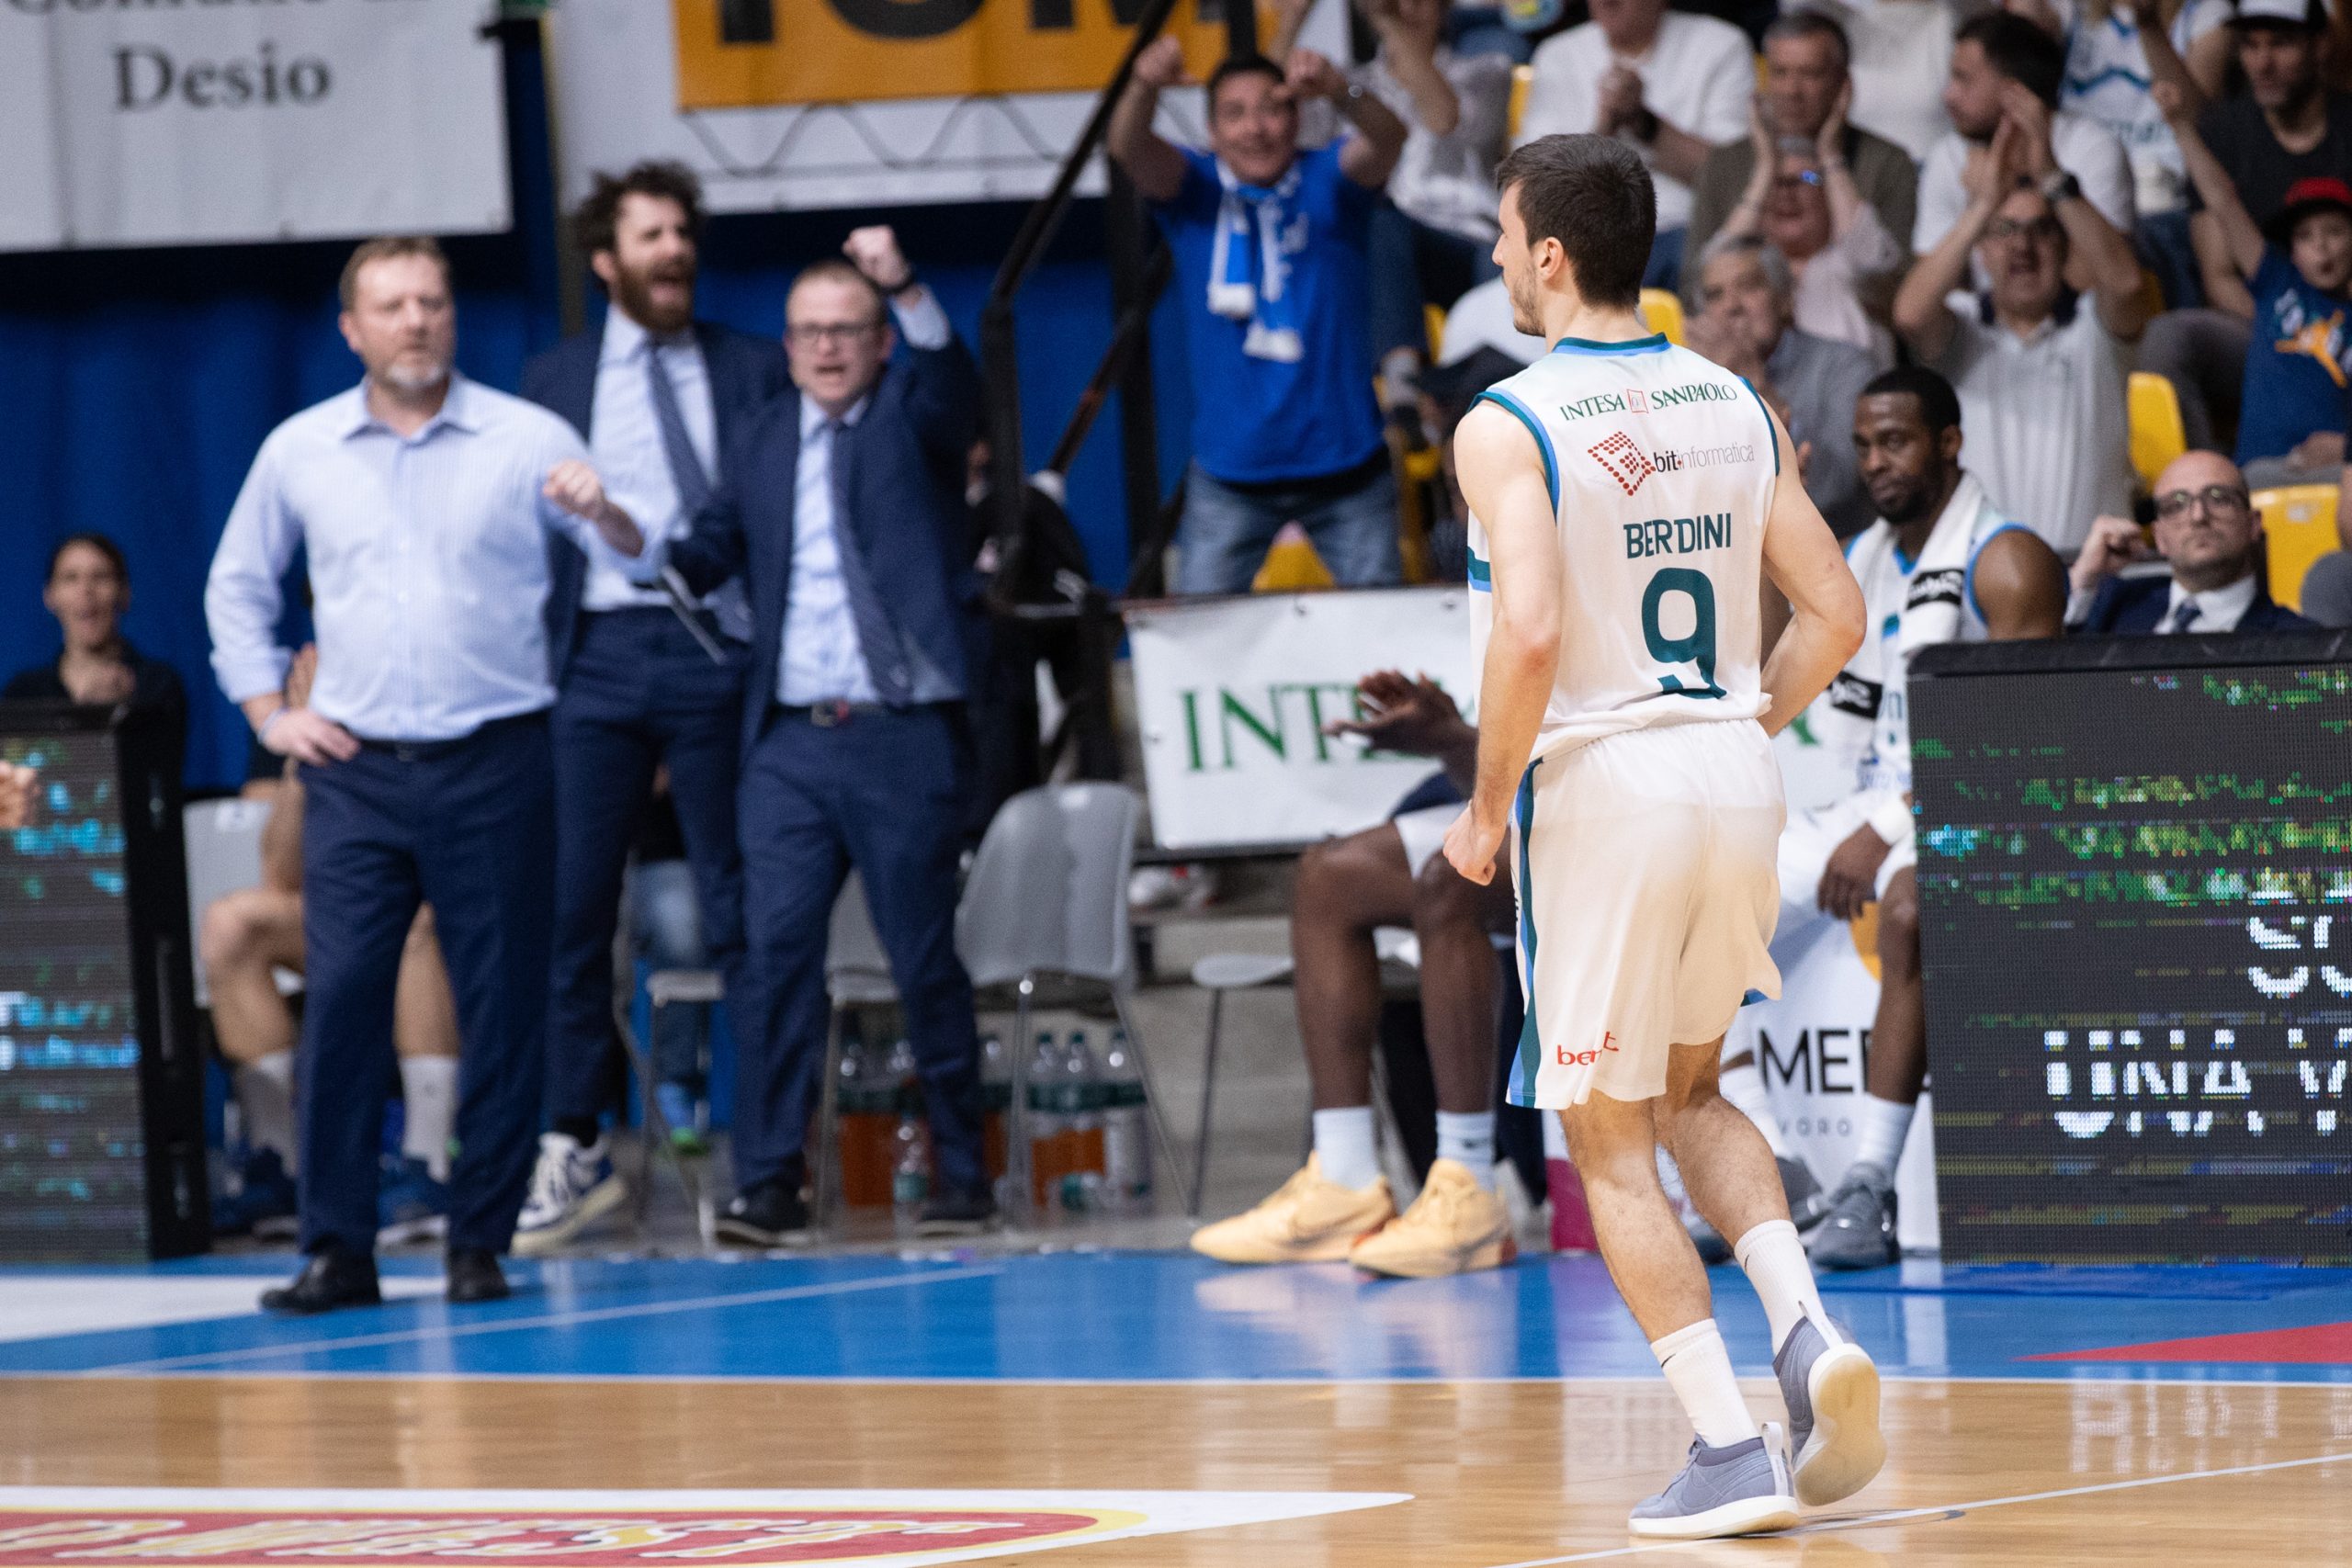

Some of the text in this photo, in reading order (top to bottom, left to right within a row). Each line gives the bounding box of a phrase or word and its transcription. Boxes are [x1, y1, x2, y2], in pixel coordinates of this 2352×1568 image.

[114, 40, 332, 110] Desio
[1560, 382, 1737, 421] INTESA SANPAOLO
[1623, 513, 1731, 558] BERDINI
[1641, 567, 1727, 699] 9
